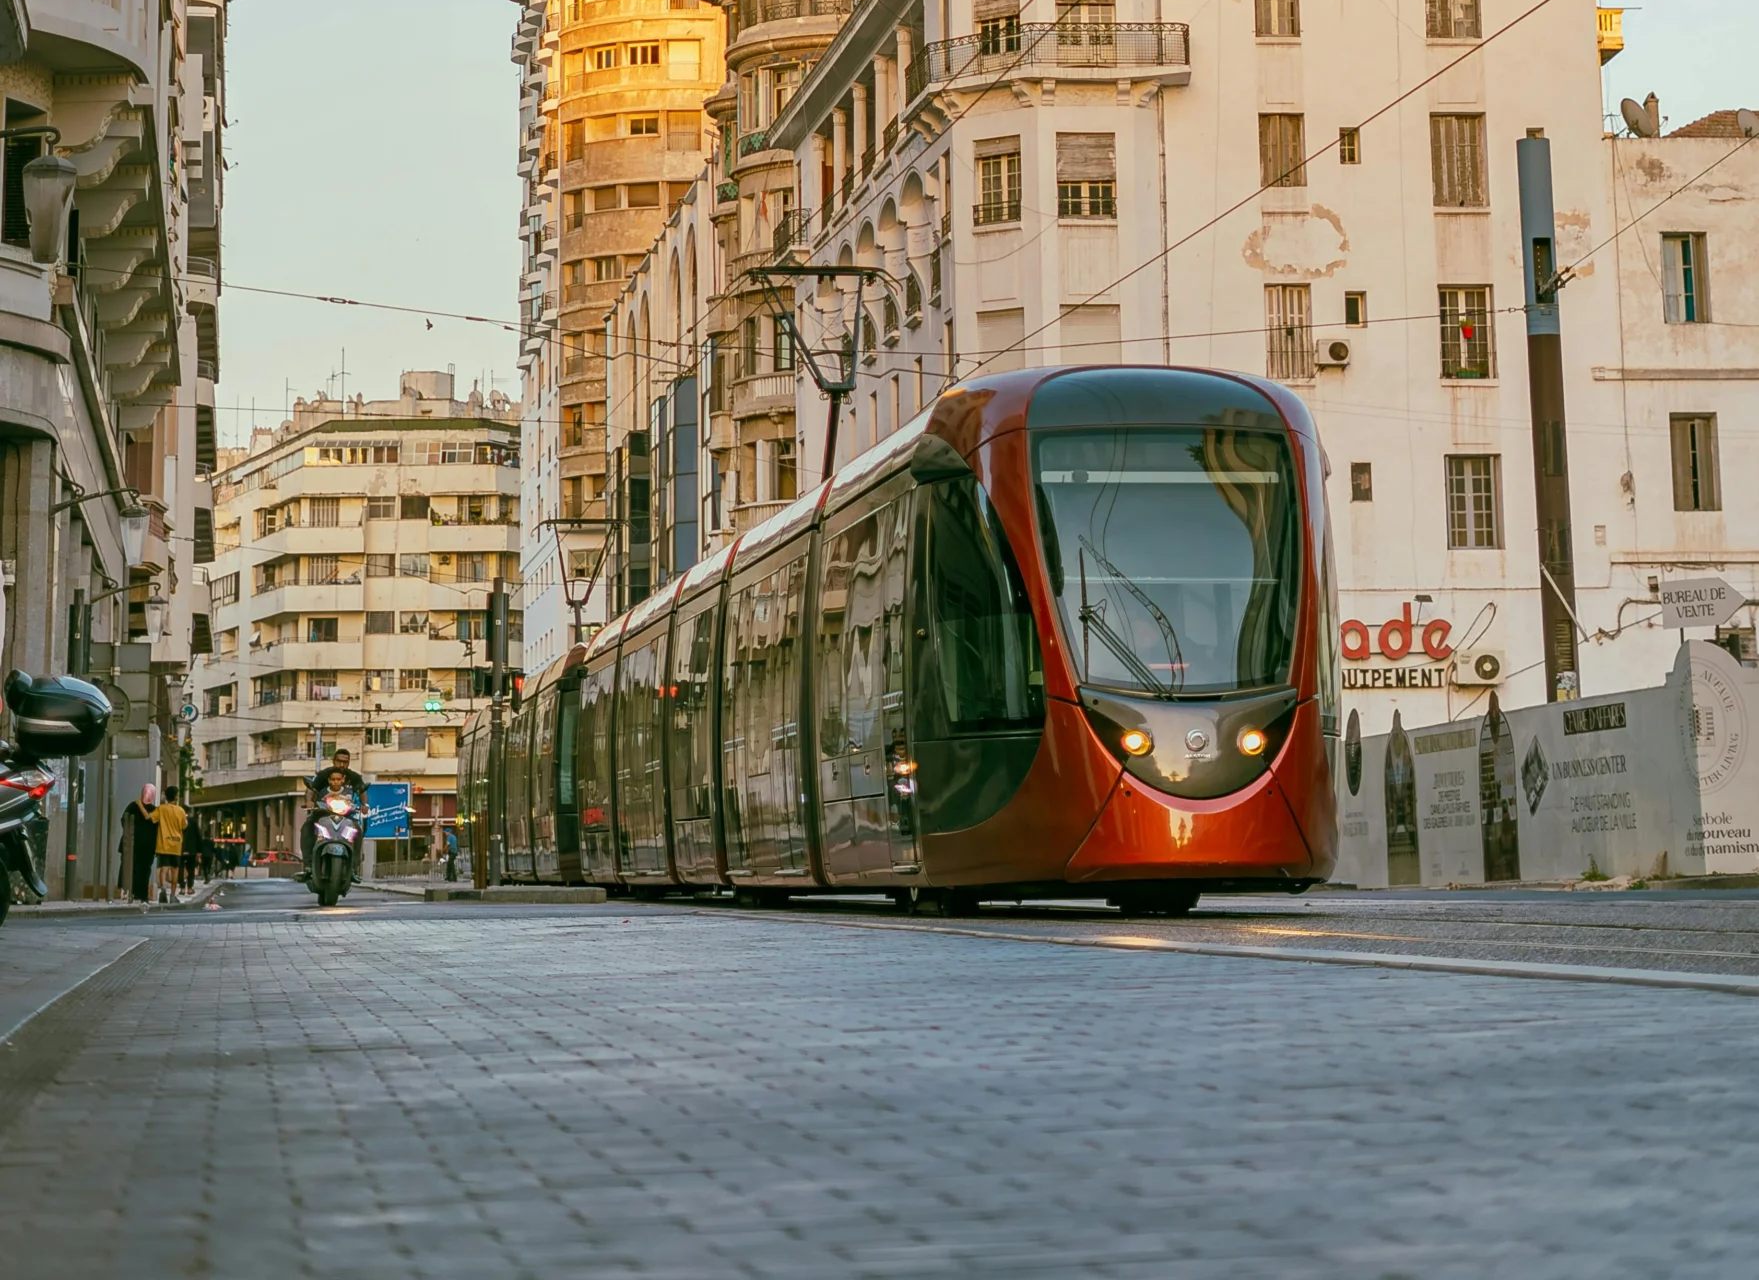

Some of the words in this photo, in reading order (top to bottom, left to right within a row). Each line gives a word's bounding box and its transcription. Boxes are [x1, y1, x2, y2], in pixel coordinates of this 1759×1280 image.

[1663, 589, 1707, 604] BUREAU
[1710, 588, 1726, 600] DE
[1676, 604, 1715, 618] VENTE
[1595, 754, 1627, 776] CENTER
[1596, 792, 1631, 810] STANDING
[1698, 841, 1759, 859] dynamism
